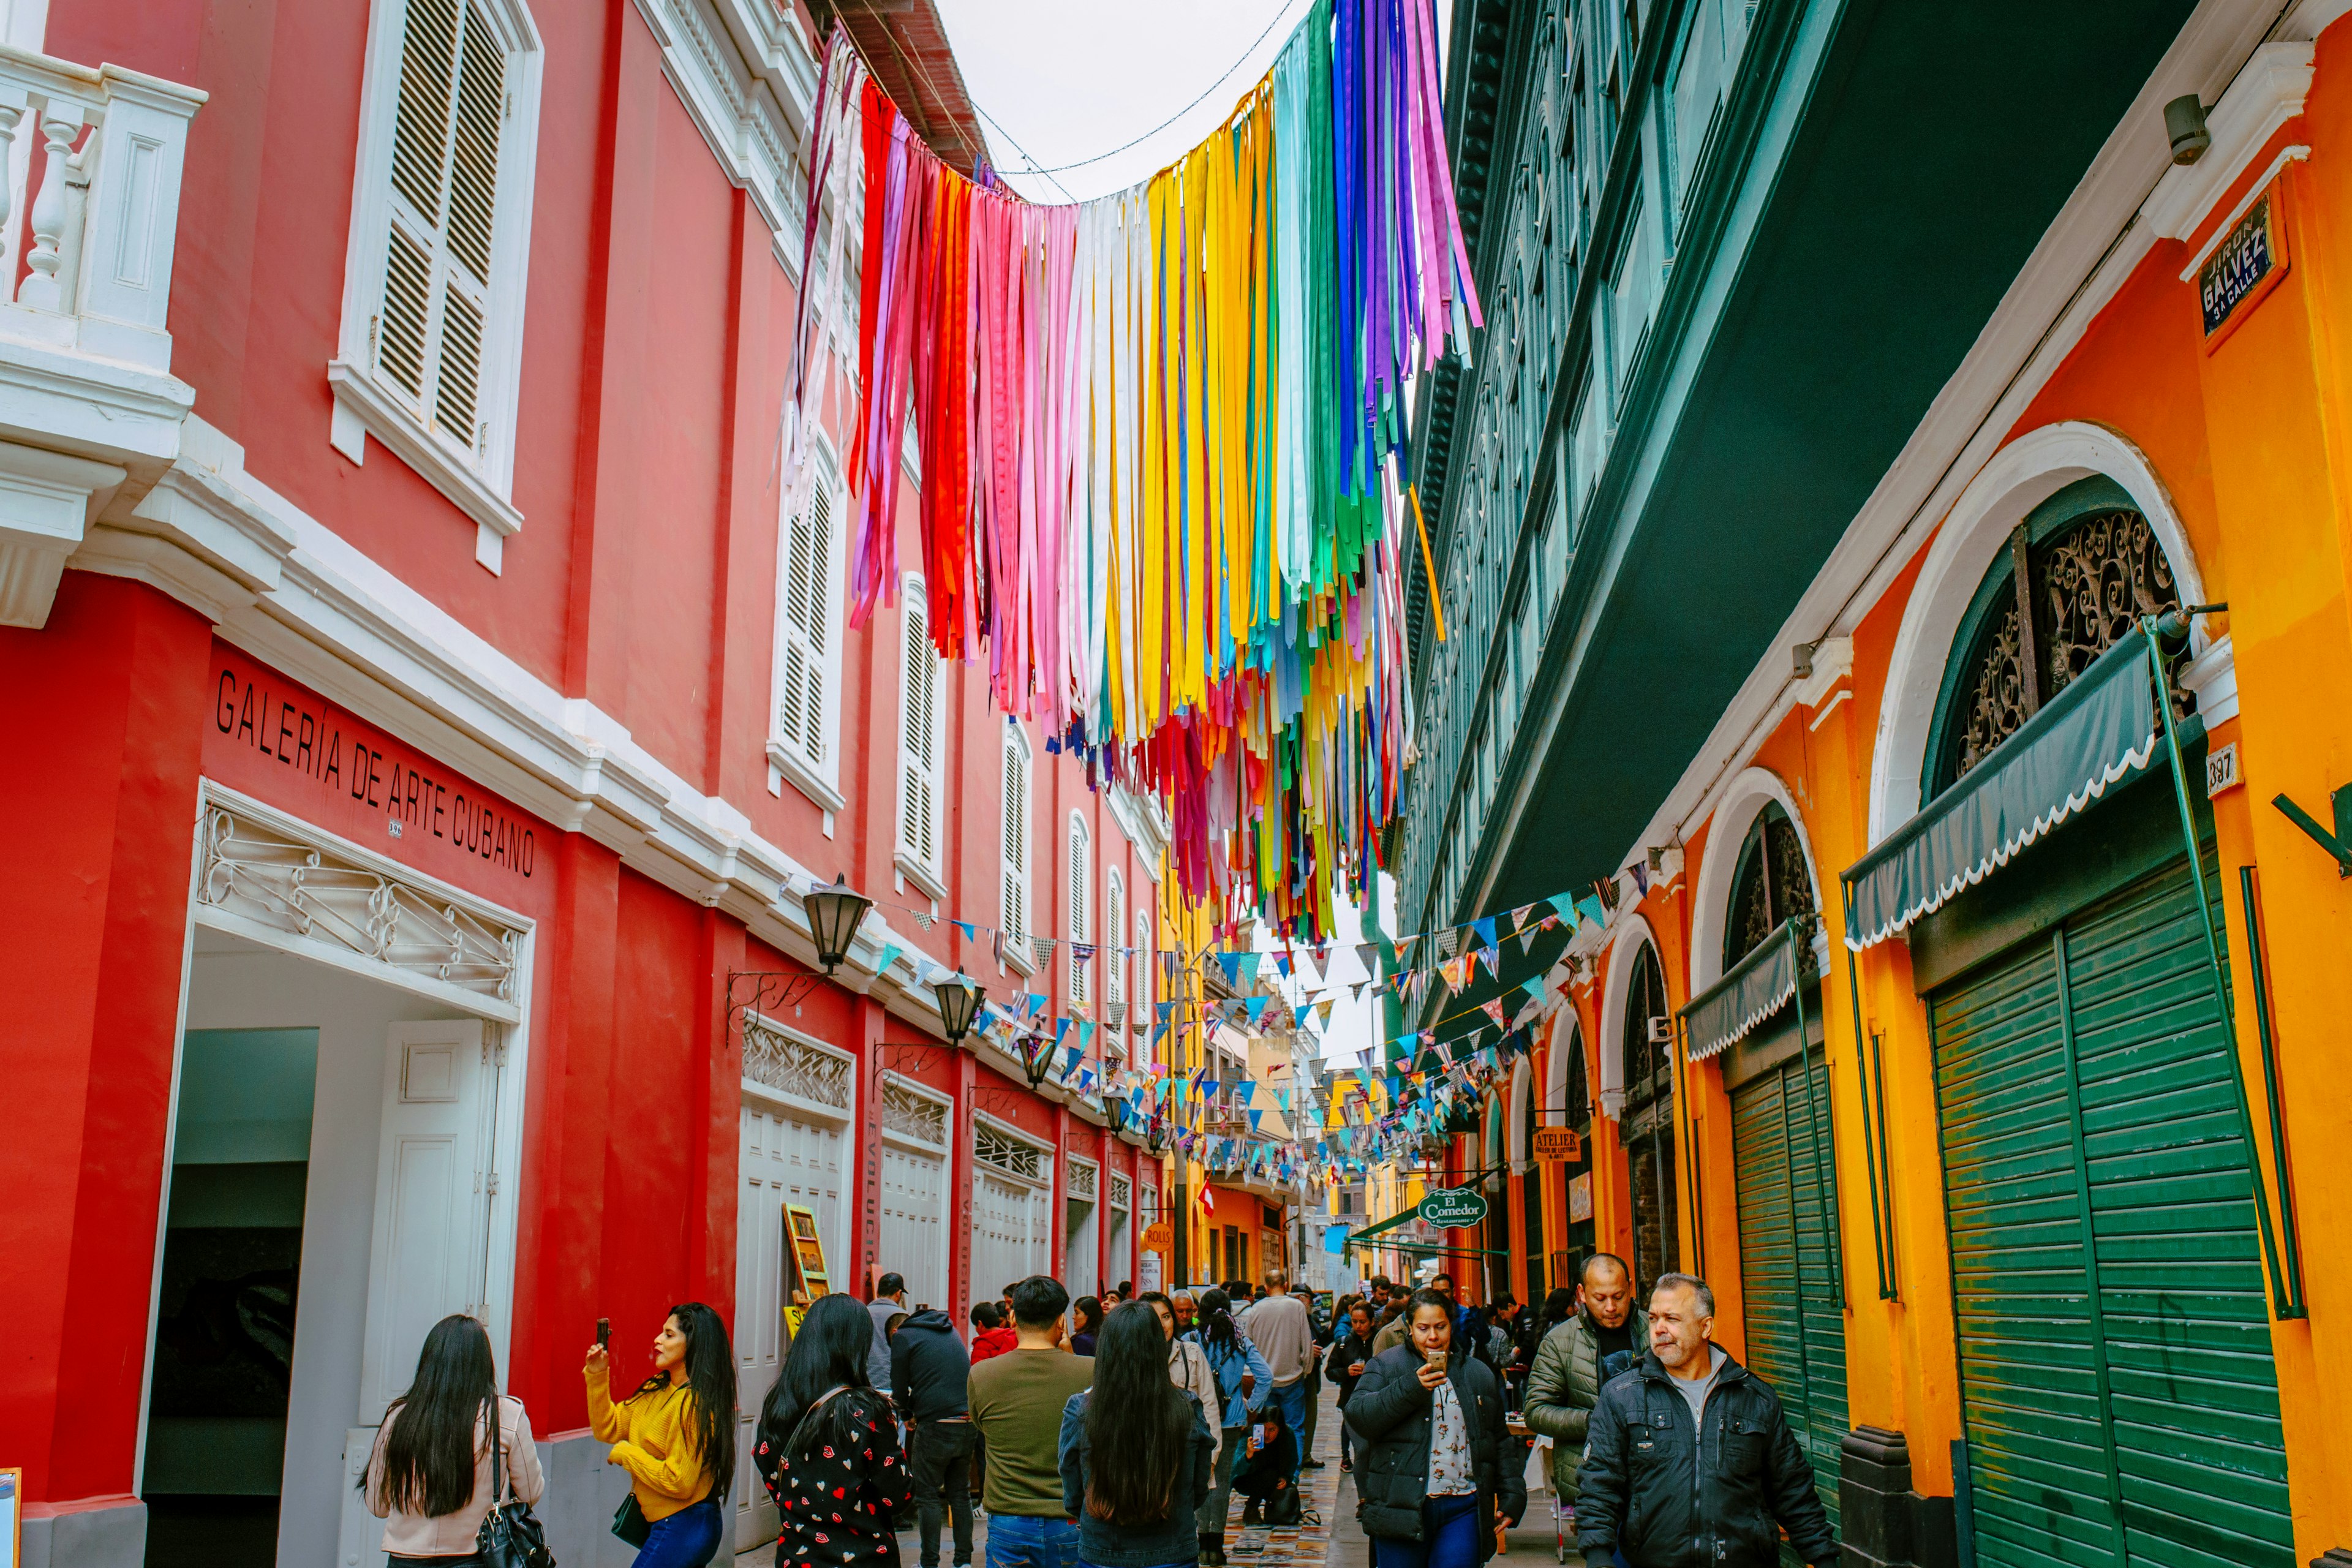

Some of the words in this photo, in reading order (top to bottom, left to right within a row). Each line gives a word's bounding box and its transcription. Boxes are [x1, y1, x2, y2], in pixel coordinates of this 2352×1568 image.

[2227, 263, 2258, 305] CALLE
[217, 669, 339, 790] GALERÍA
[352, 742, 382, 809] DE
[387, 763, 446, 839] ARTE
[453, 794, 534, 878] CUBANO
[2209, 752, 2231, 787] 397
[390, 823, 401, 834] 396
[1536, 1133, 1576, 1147] ATELIER
[1445, 1197, 1455, 1207] El
[1425, 1204, 1480, 1219] Comedor
